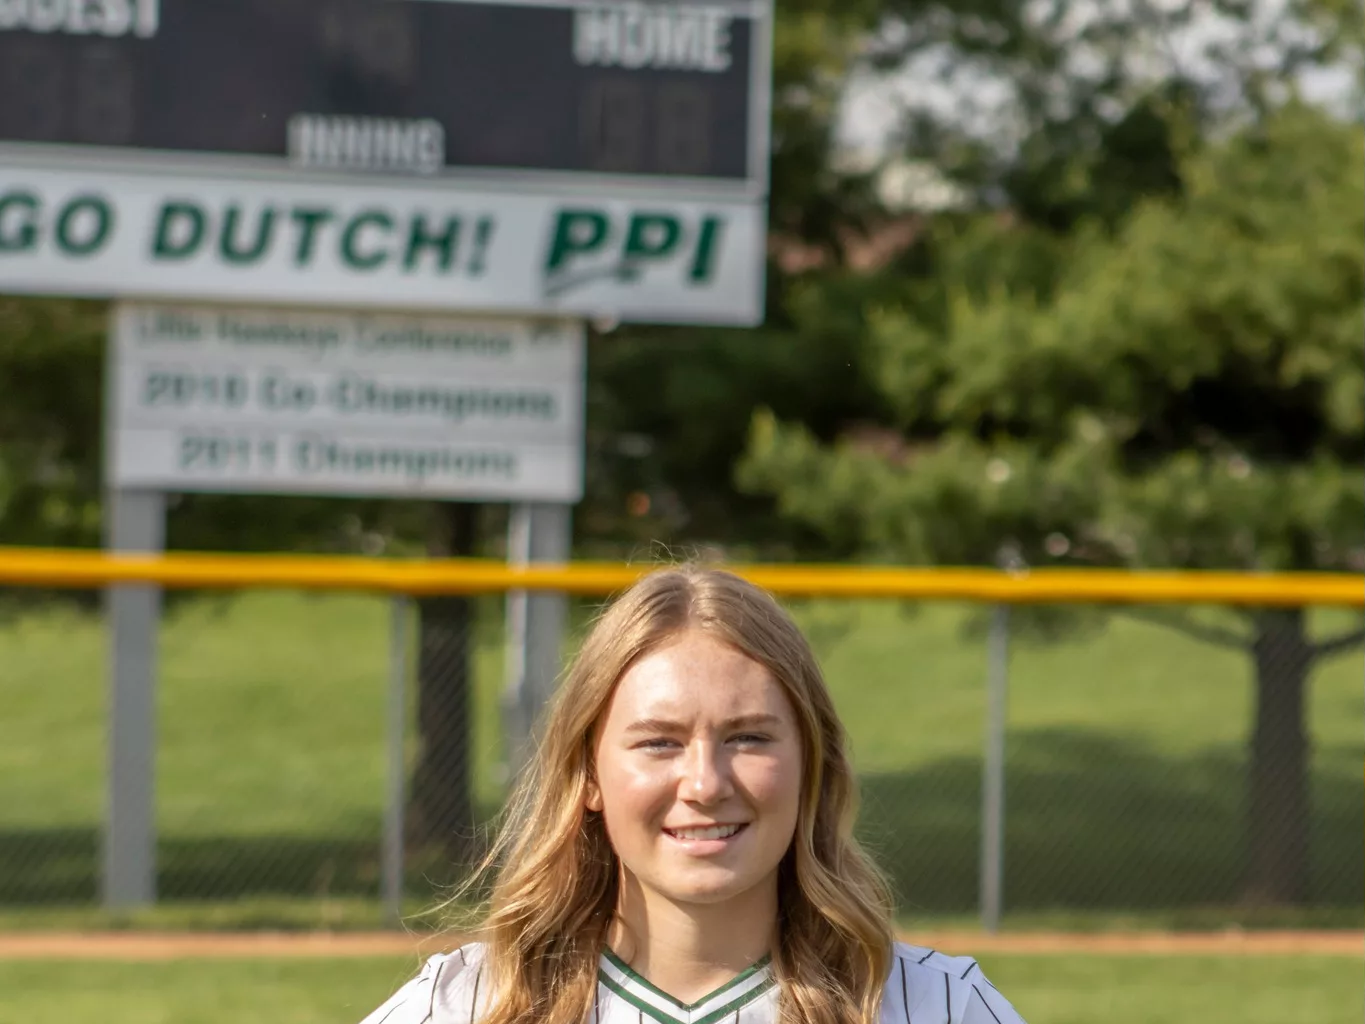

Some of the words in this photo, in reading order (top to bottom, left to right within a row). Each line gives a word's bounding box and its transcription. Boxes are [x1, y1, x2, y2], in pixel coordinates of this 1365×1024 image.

[573, 6, 732, 70] HOME
[288, 113, 446, 173] INNING
[0, 189, 115, 257] GO
[150, 198, 498, 277] DUTCH!
[543, 208, 729, 290] PPI
[179, 435, 277, 473] 2011
[293, 436, 518, 483] Champions
